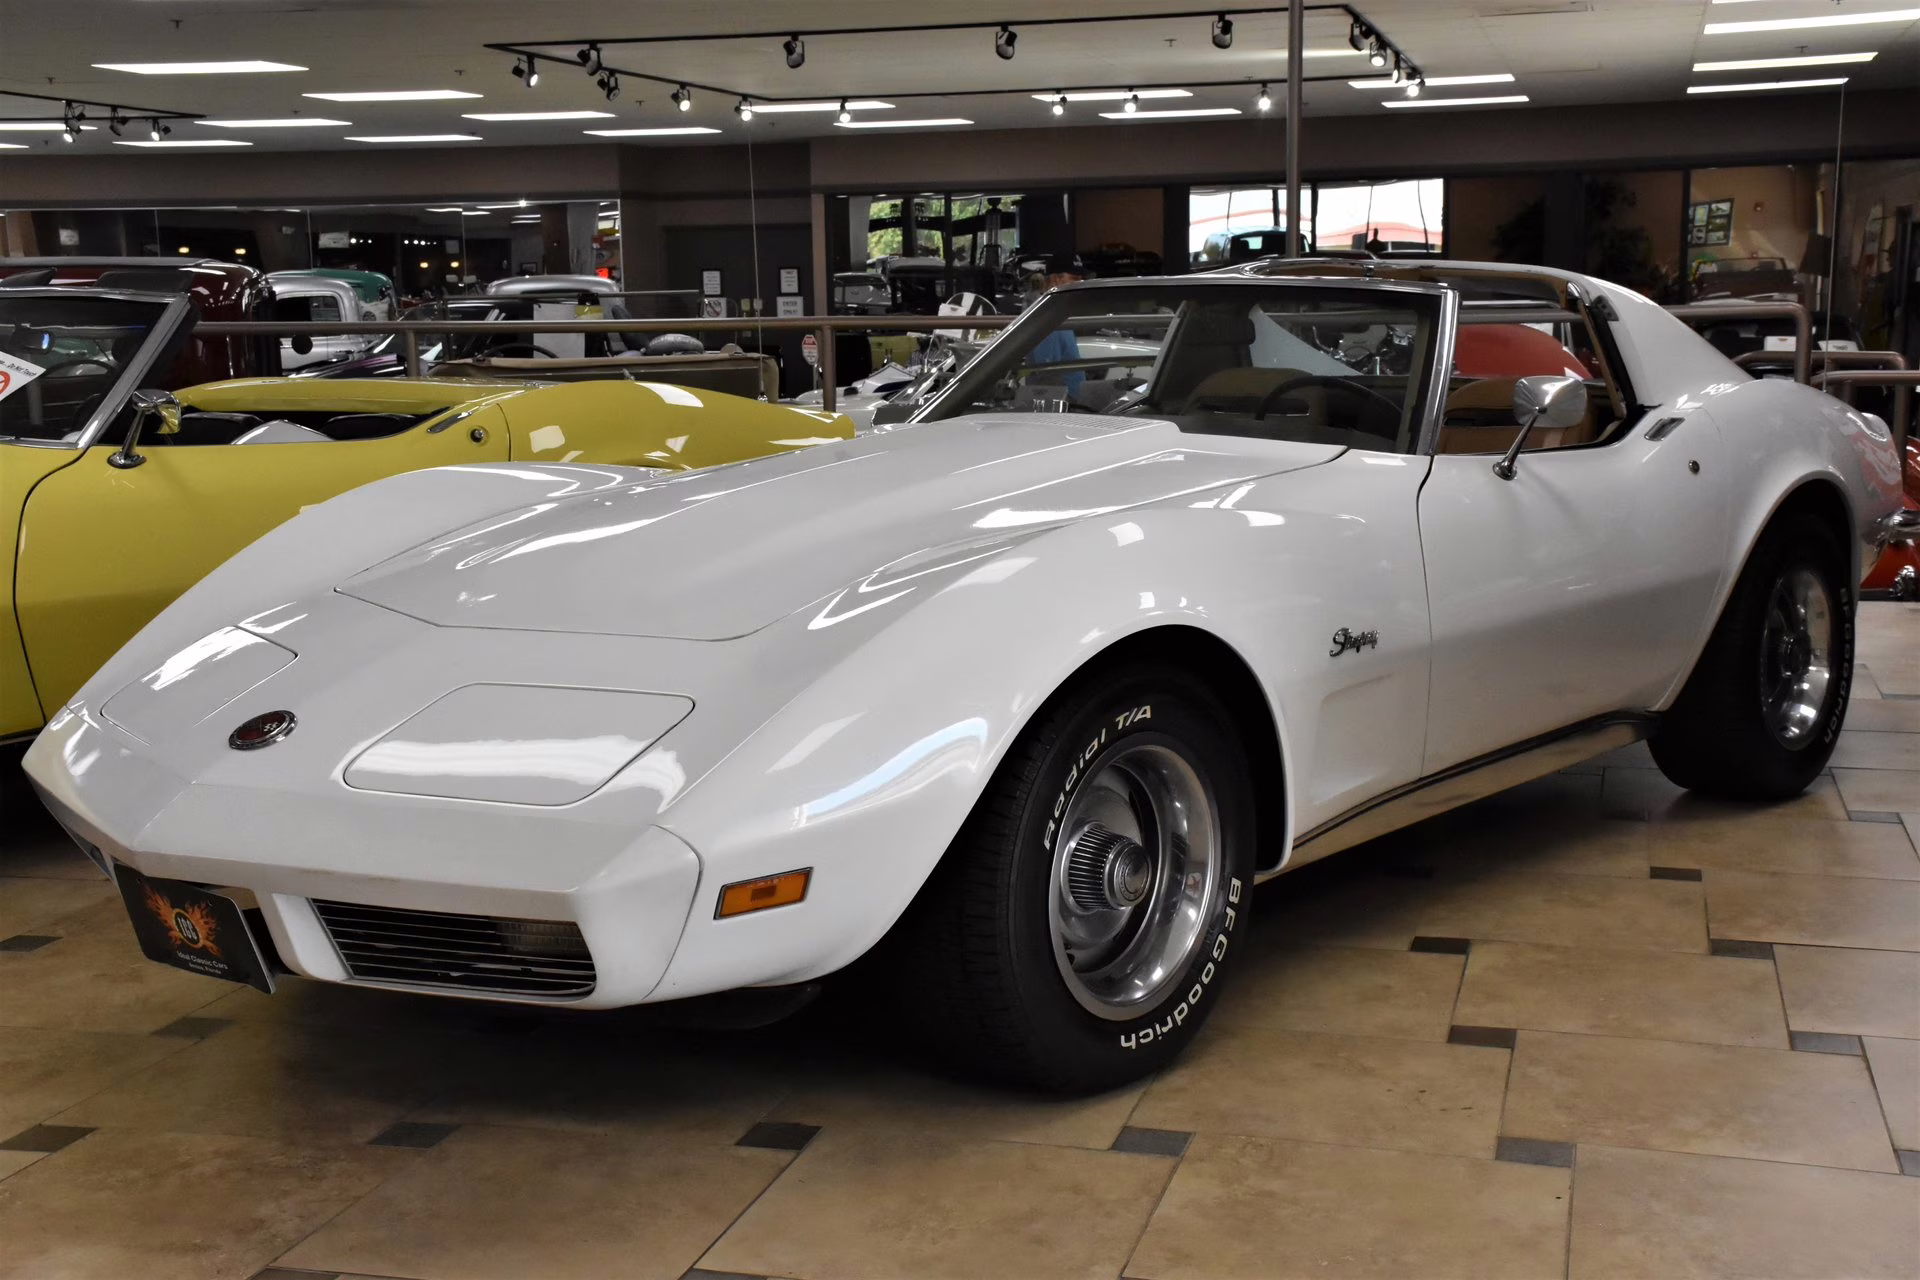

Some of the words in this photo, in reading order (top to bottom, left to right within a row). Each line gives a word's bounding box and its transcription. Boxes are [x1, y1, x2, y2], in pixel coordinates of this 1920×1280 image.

[1043, 727, 1106, 851] Radial
[1115, 704, 1152, 731] T/A
[212, 960, 229, 970] Cars
[1120, 876, 1242, 1049] BFGoodrich
